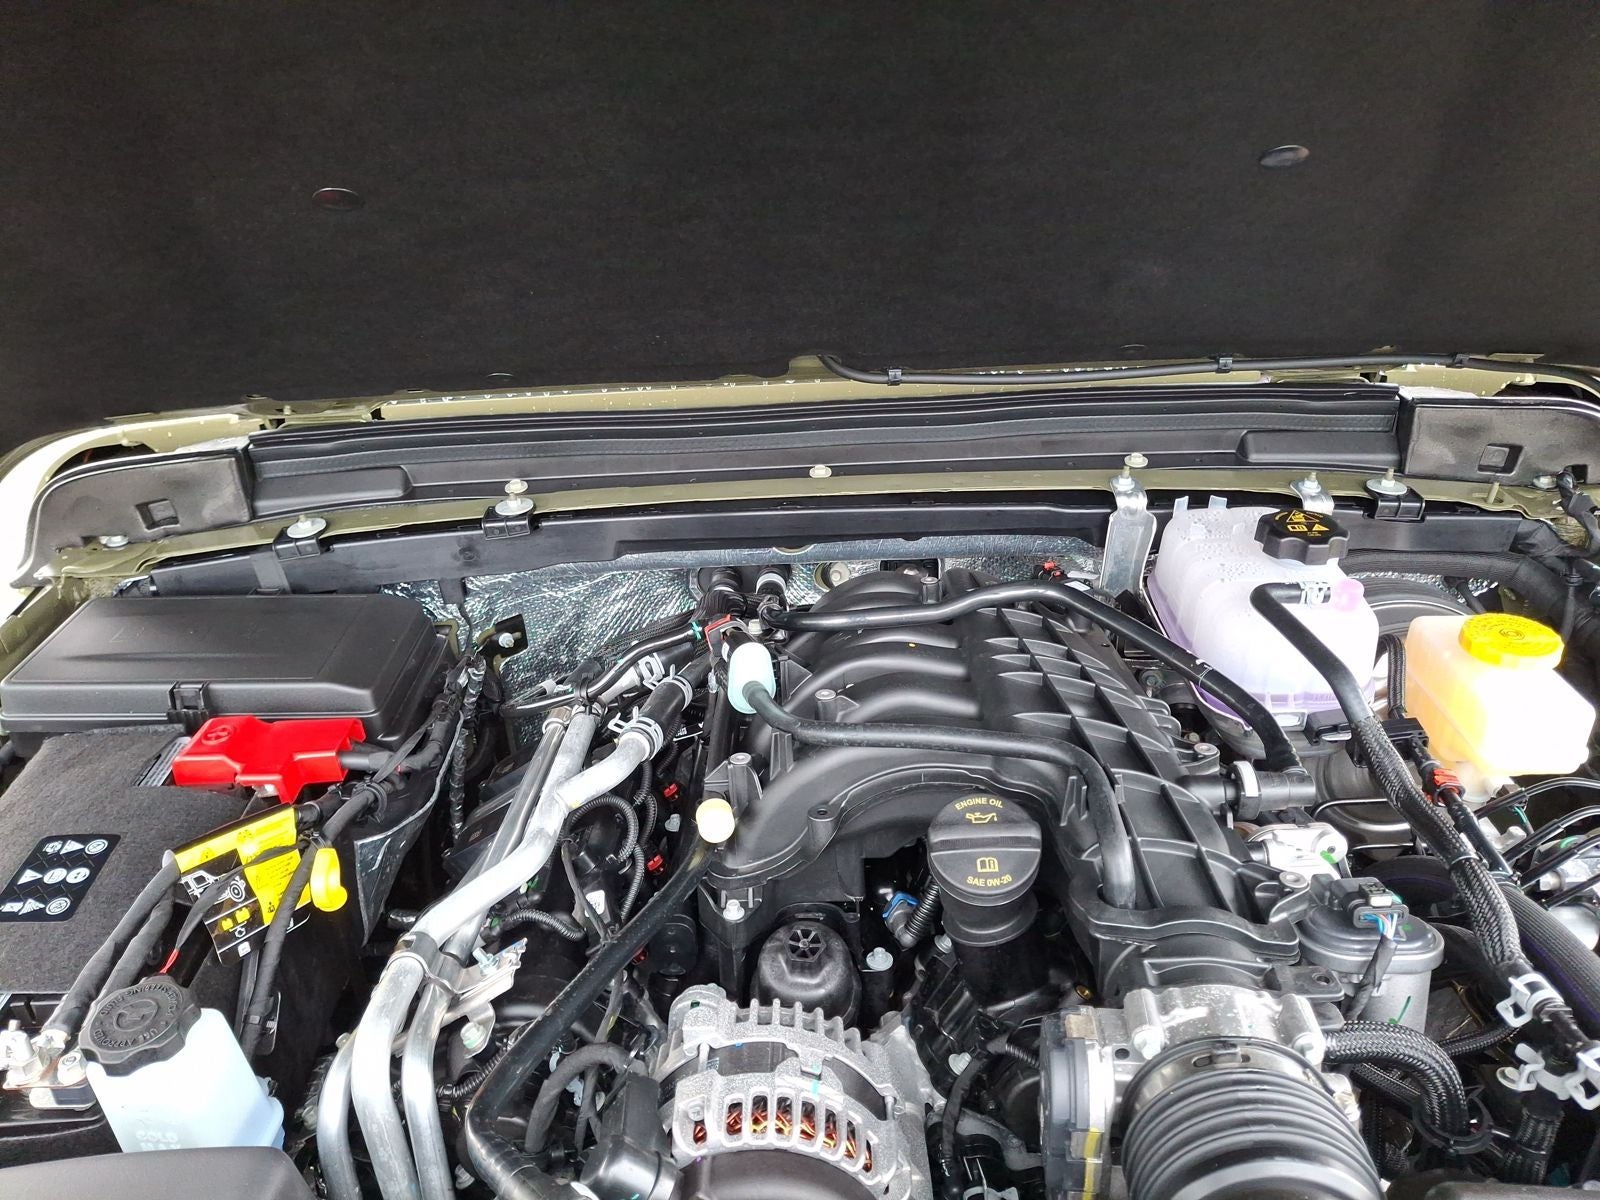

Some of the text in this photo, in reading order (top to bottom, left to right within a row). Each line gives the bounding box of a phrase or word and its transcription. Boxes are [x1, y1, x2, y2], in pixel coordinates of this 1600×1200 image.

[954, 797, 1004, 811] ENGINE OIL
[966, 874, 1013, 887] SAE 0W-20
[135, 1129, 179, 1143] COLD
